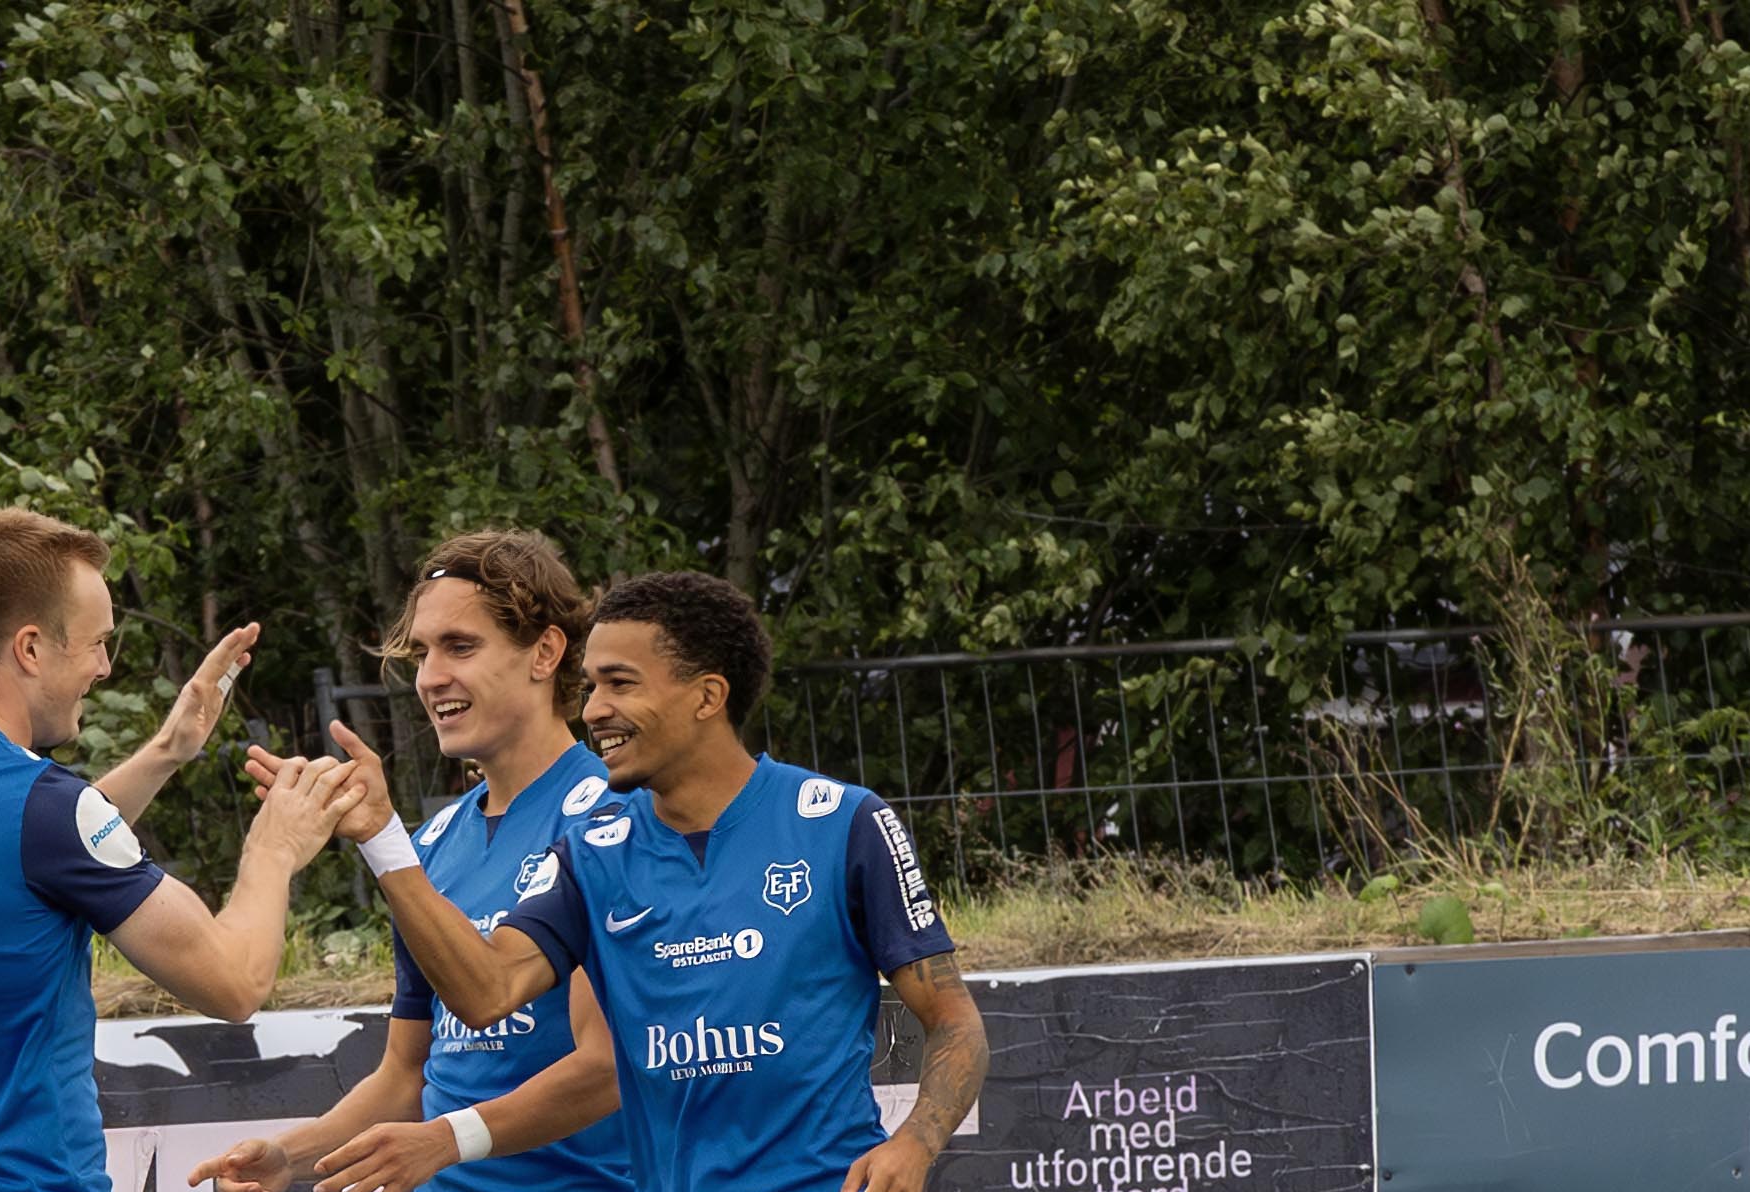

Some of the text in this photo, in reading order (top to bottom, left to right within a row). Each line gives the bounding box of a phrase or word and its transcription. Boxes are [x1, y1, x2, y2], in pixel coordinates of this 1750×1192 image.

[654, 932, 732, 960] SpareBank
[646, 1016, 785, 1069] Bohus
[1534, 1014, 1750, 1088] Comf
[1062, 1075, 1197, 1119] Arbeid
[1090, 1109, 1176, 1150] med
[1011, 1140, 1252, 1188] utfordrende
